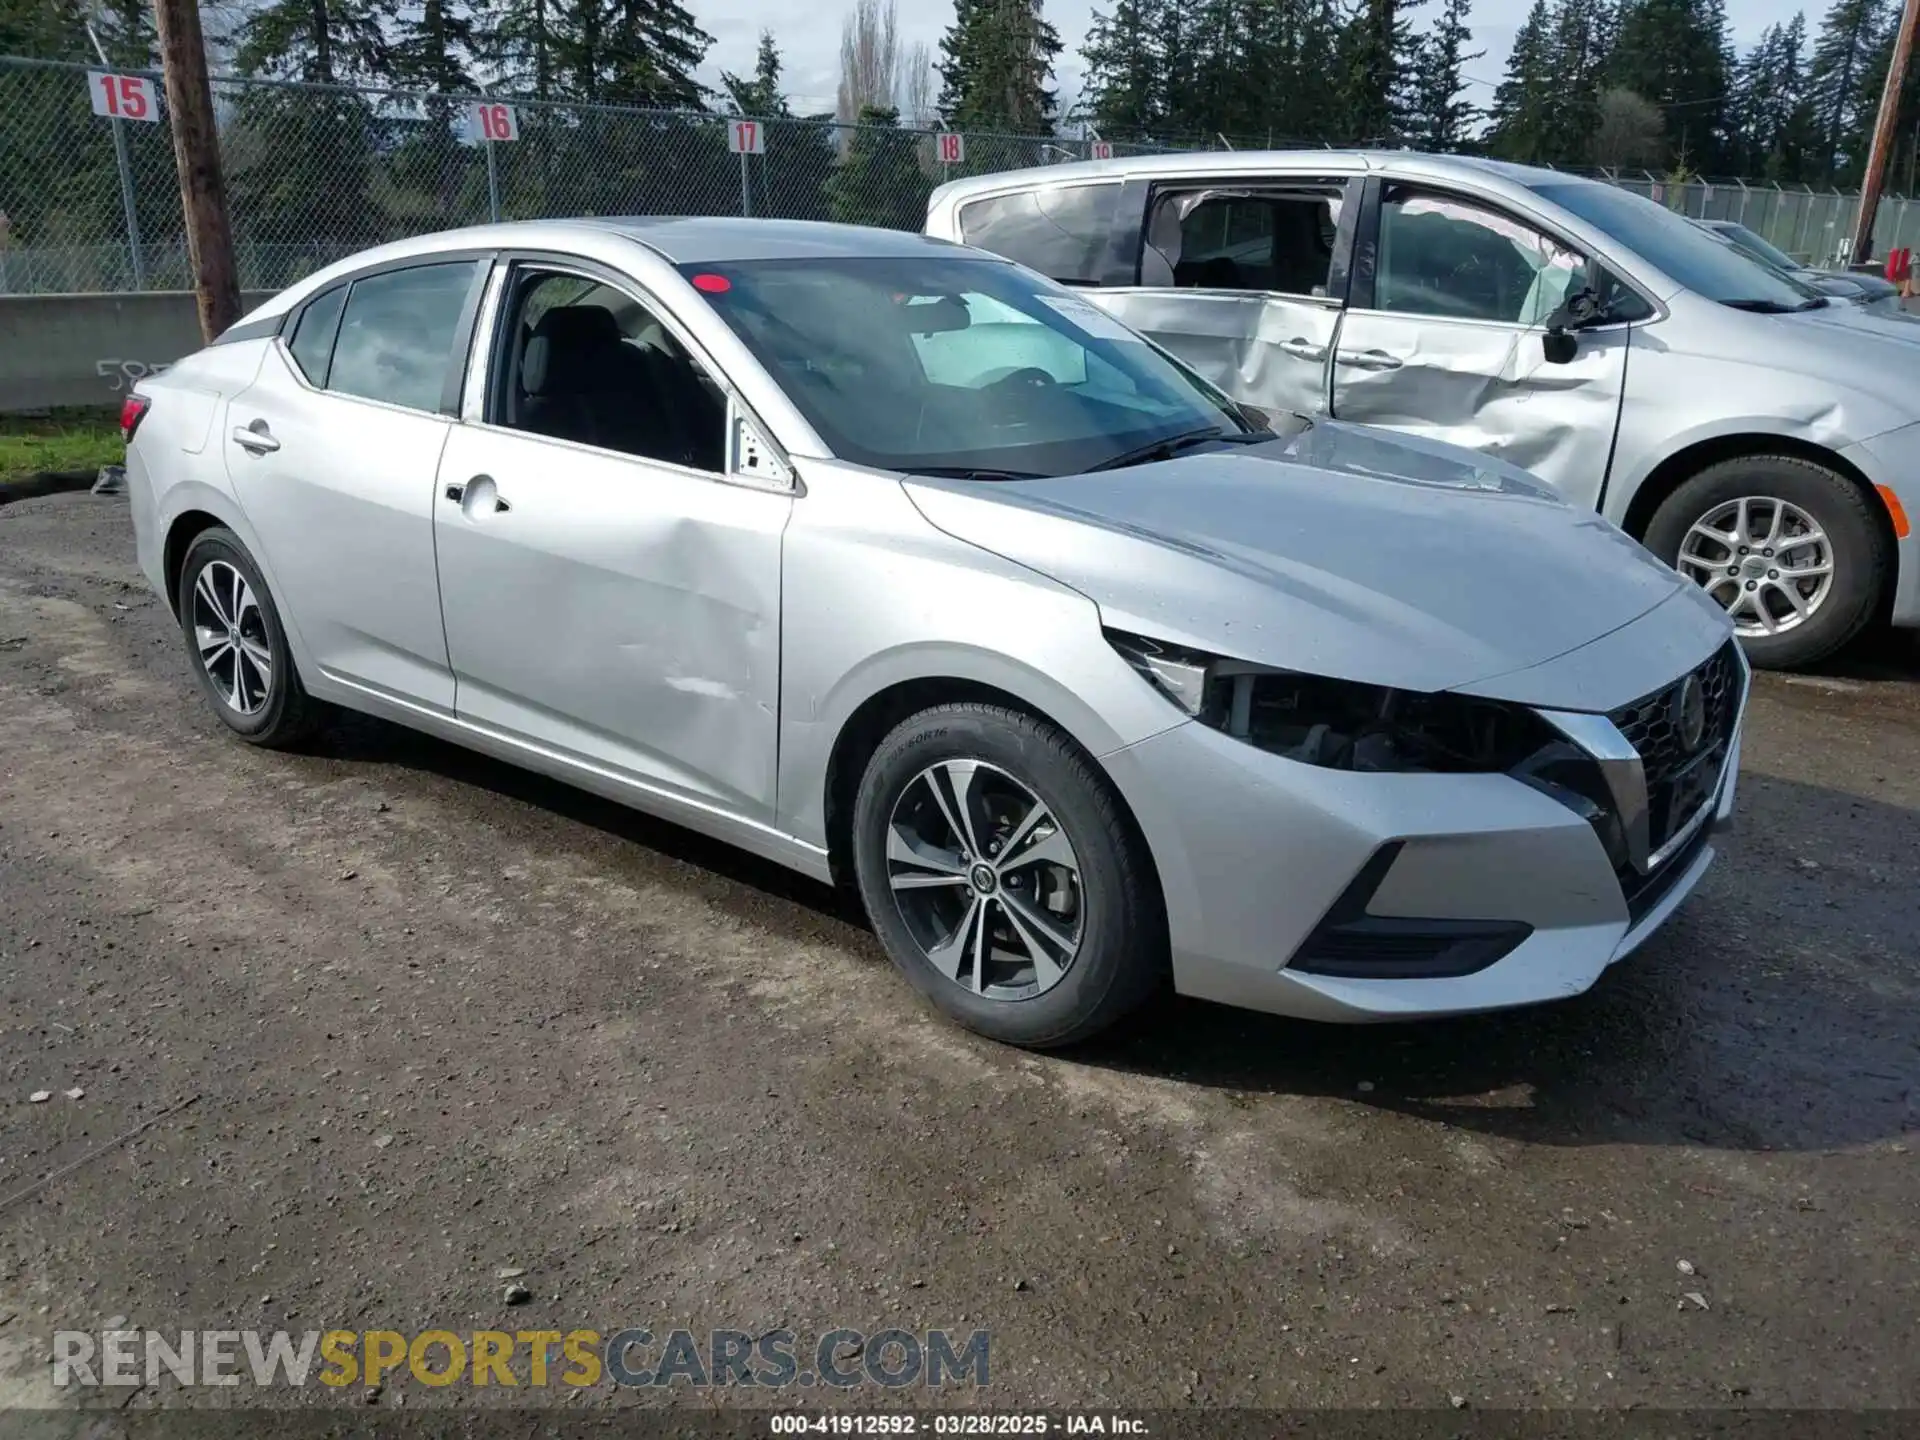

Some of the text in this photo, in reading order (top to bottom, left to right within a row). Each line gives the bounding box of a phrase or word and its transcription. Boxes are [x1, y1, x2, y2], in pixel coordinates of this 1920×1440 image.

[100, 75, 147, 118] 15
[479, 105, 511, 138] 16
[735, 123, 756, 151] 17
[941, 135, 959, 160] 18
